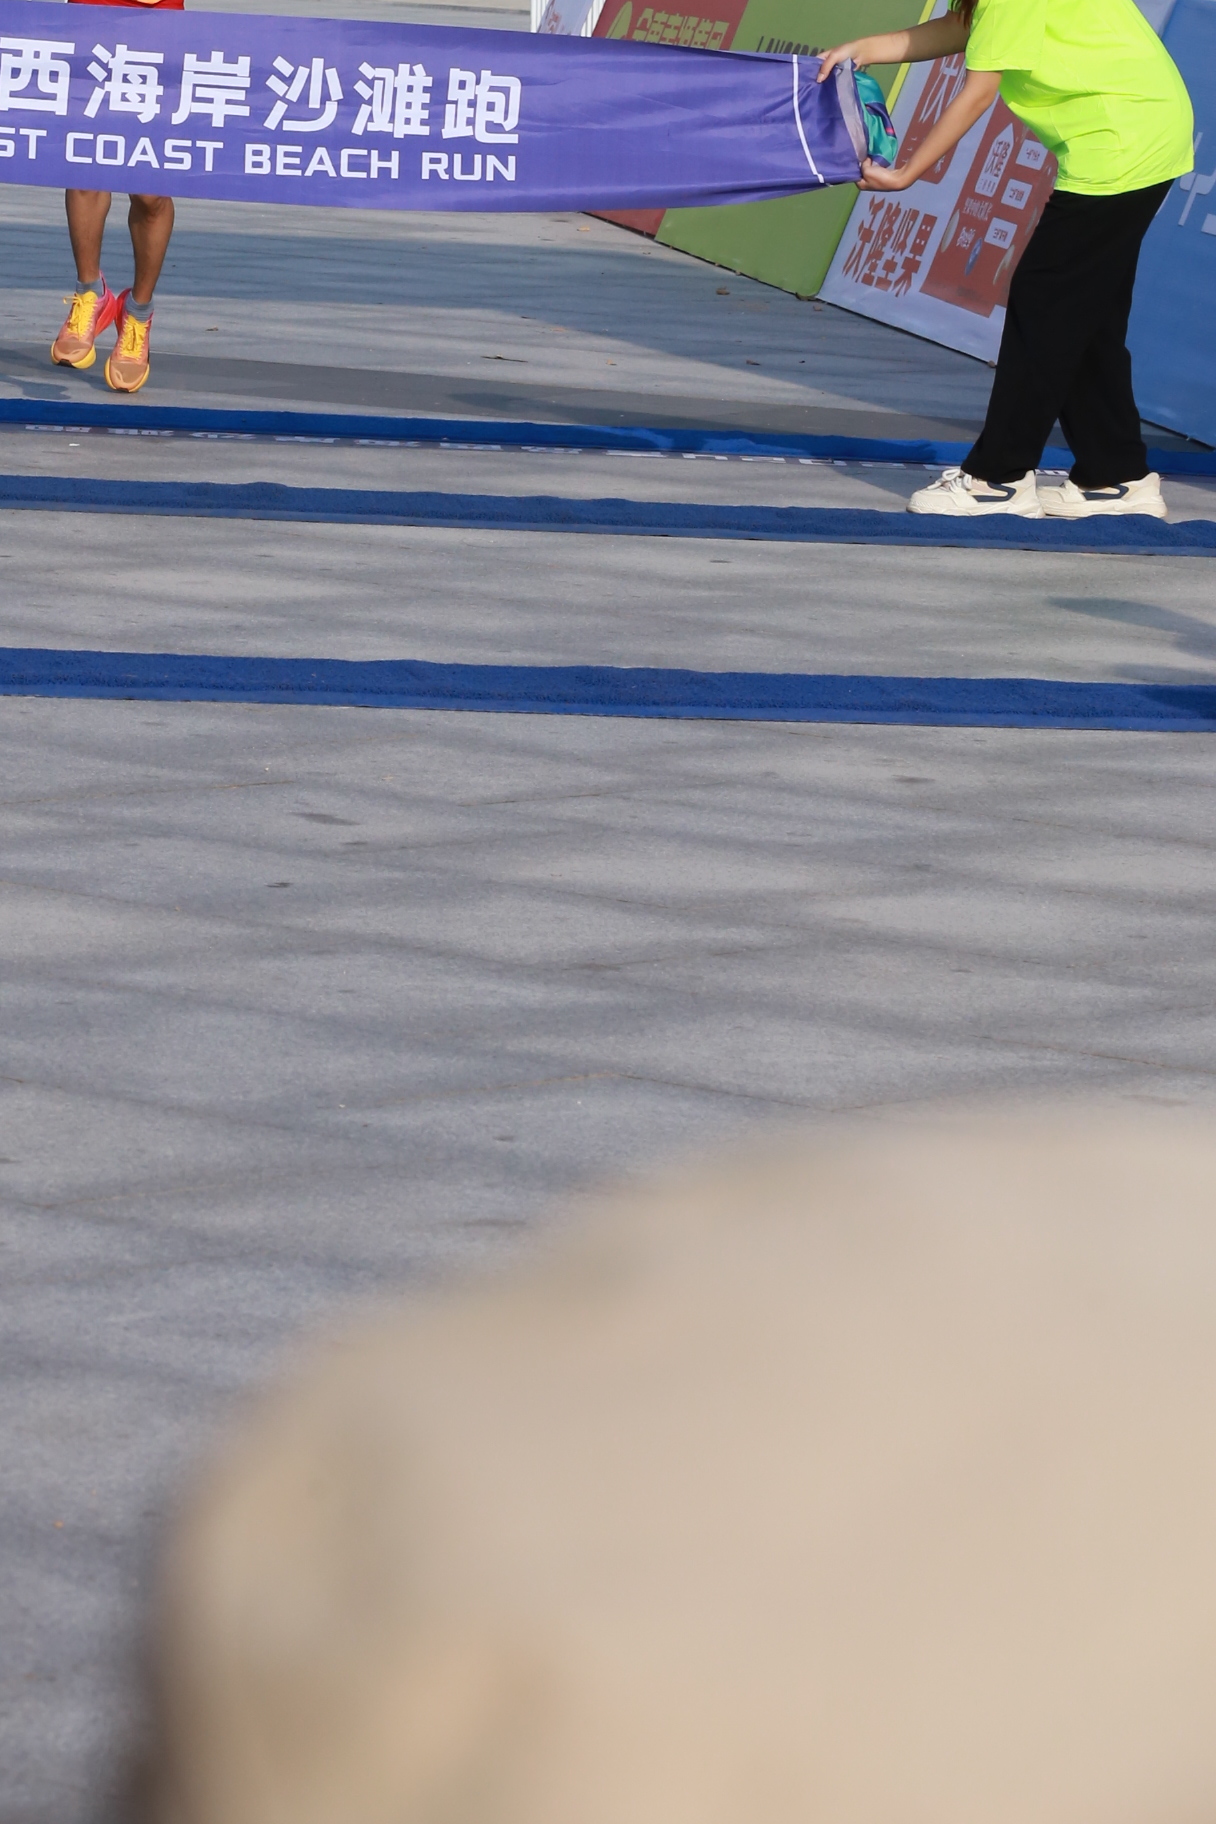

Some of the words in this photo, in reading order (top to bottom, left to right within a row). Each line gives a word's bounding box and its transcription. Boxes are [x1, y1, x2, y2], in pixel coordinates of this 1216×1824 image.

[65, 131, 224, 172] COAST
[244, 143, 400, 179] BEACH
[421, 151, 517, 182] RUN
[841, 194, 939, 298] 沃隆坚果
